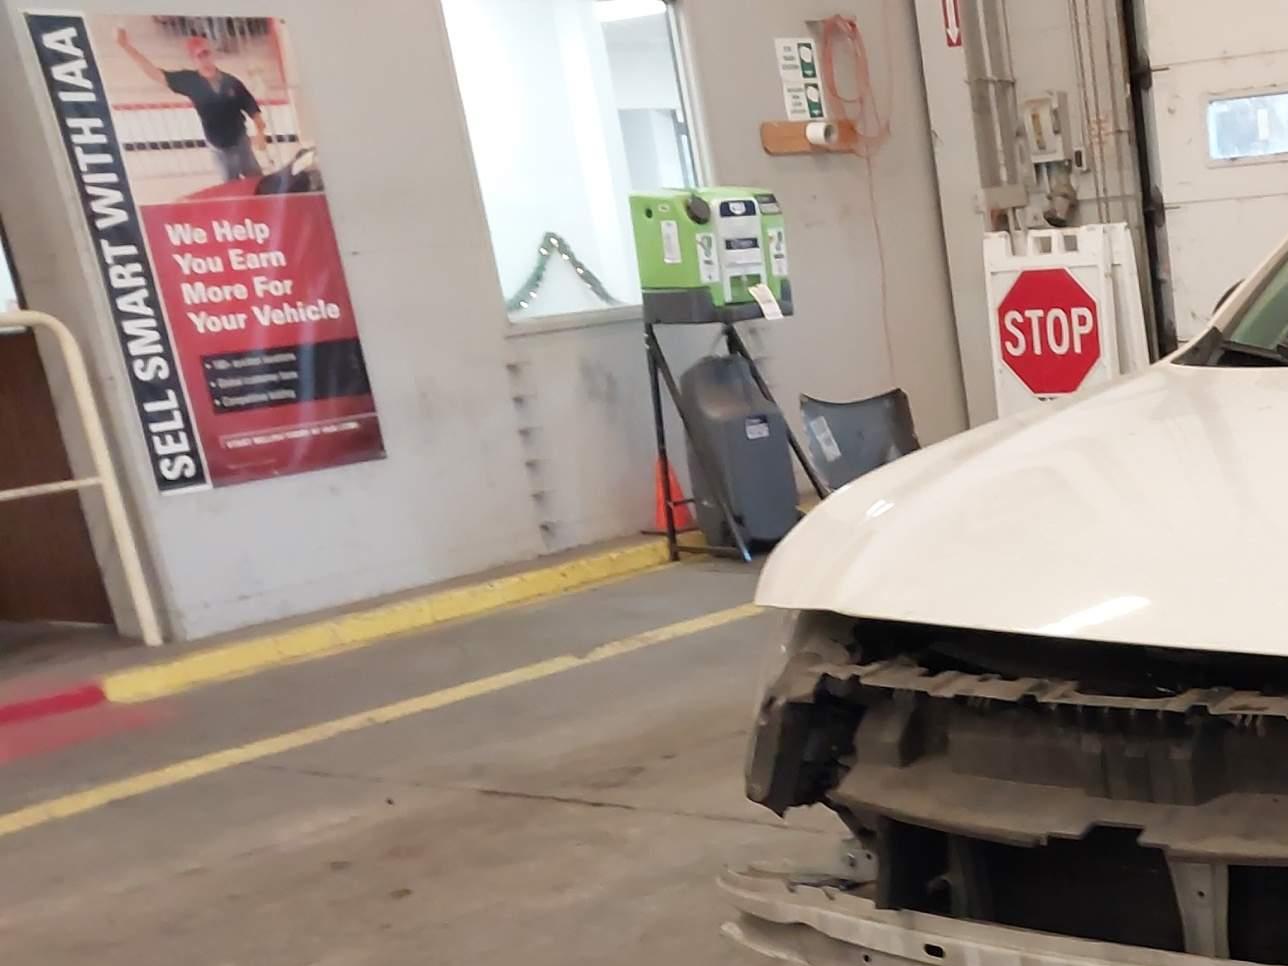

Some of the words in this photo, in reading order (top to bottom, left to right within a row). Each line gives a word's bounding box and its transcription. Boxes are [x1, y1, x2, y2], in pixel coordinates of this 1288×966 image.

[43, 26, 96, 102] IAA
[66, 117, 129, 230] WITH
[165, 223, 207, 246] We
[213, 219, 270, 245] Help
[173, 253, 223, 275] You
[228, 249, 286, 271] Earn
[105, 239, 170, 382] SMART
[182, 282, 248, 304] More
[253, 276, 293, 297] For
[188, 311, 247, 333] Your
[252, 300, 341, 327] Vehicle
[1004, 307, 1093, 357] STOP
[144, 389, 196, 481] SELL
